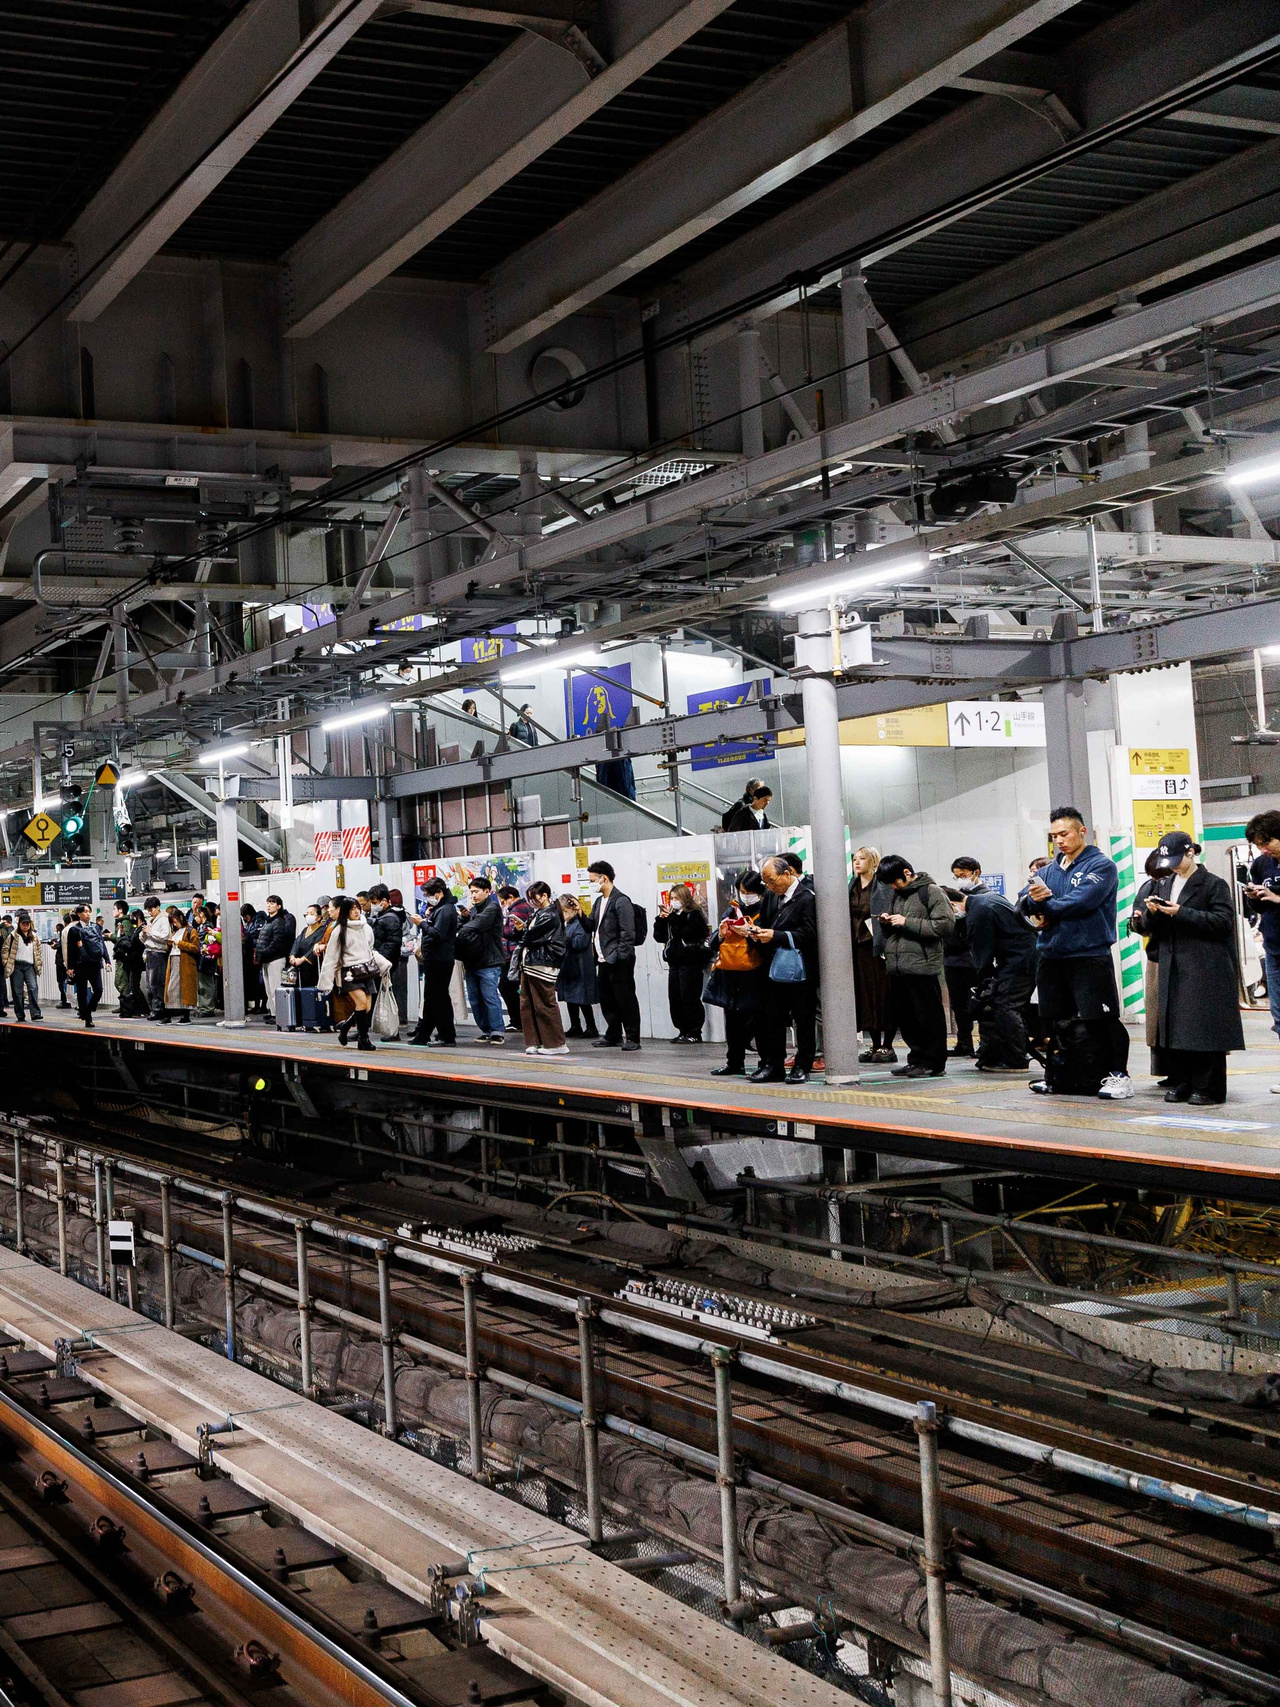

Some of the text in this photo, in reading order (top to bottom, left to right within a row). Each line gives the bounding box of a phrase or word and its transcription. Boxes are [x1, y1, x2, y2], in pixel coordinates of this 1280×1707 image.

[64, 743, 74, 756] 5
[27, 876, 34, 886] 4
[116, 878, 125, 890] 4
[58, 884, 90, 892] エレベーター
